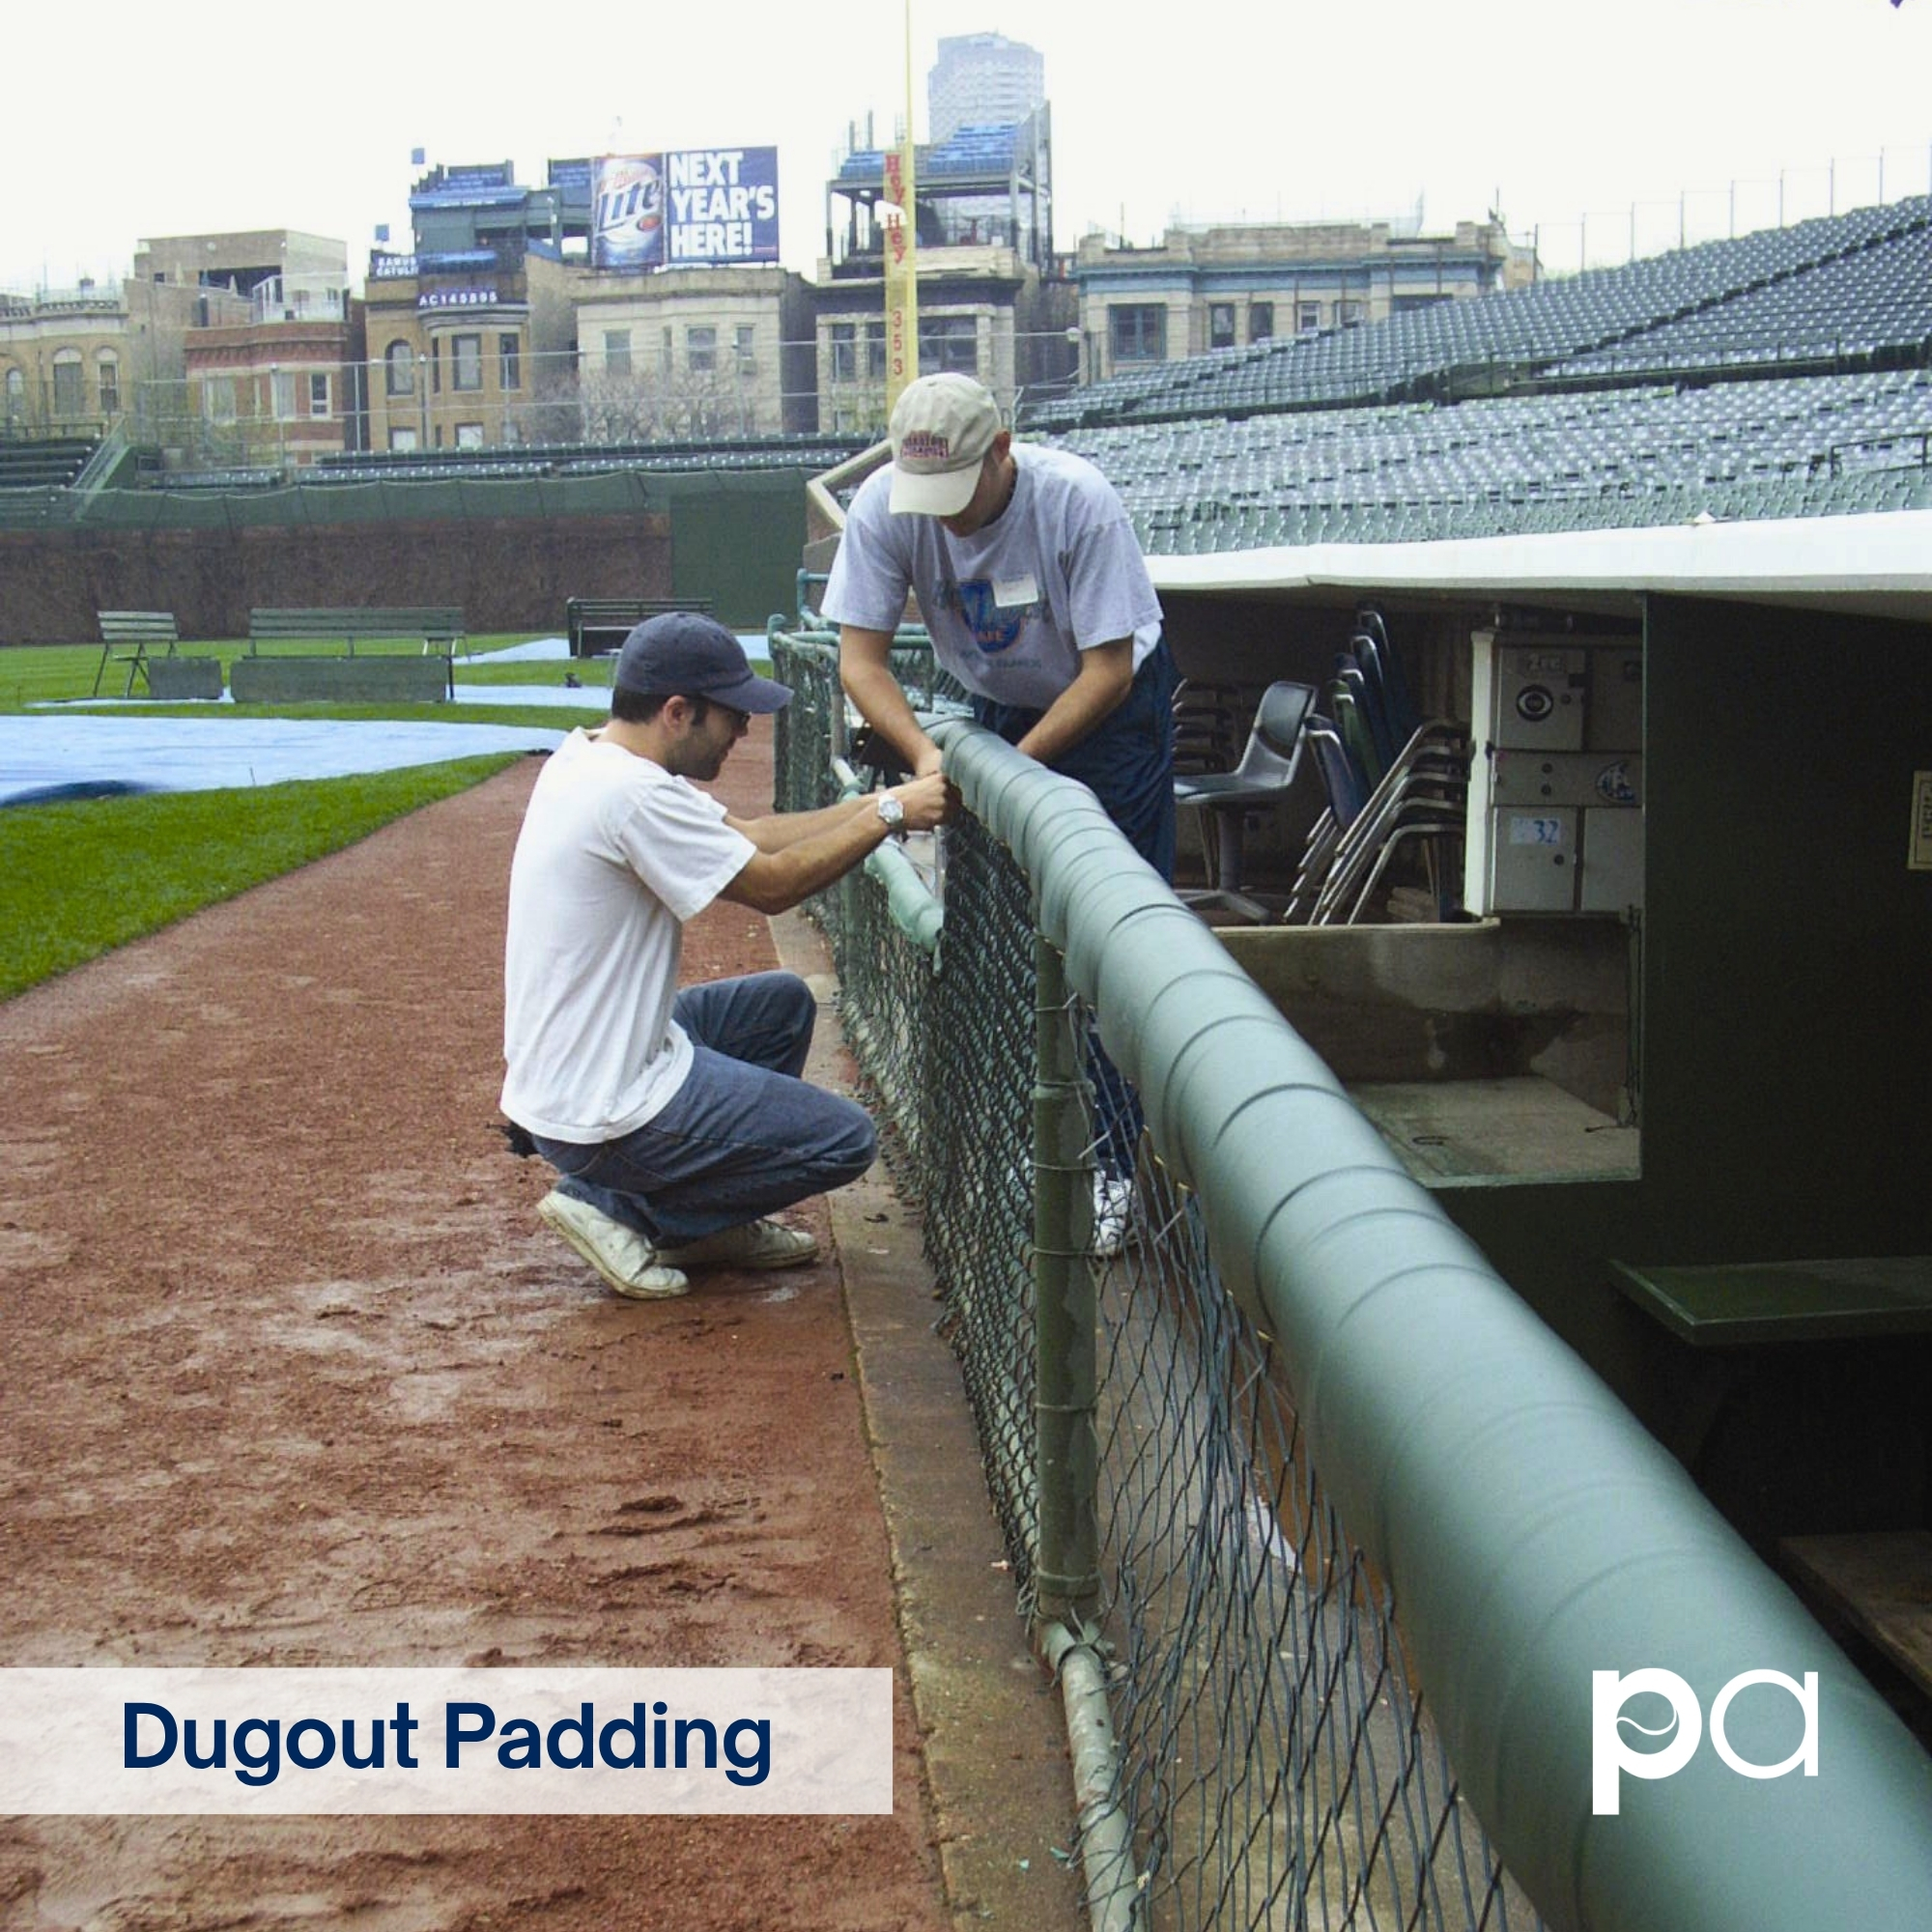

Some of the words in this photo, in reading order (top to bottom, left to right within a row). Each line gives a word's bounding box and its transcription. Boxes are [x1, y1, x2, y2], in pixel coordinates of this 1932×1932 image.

[669, 152, 744, 187] NEXT
[671, 185, 775, 222] YEAR'S
[670, 218, 753, 258] HERE!
[887, 213, 907, 265] Hey
[893, 309, 903, 376] 353
[1533, 820, 1558, 843] 32
